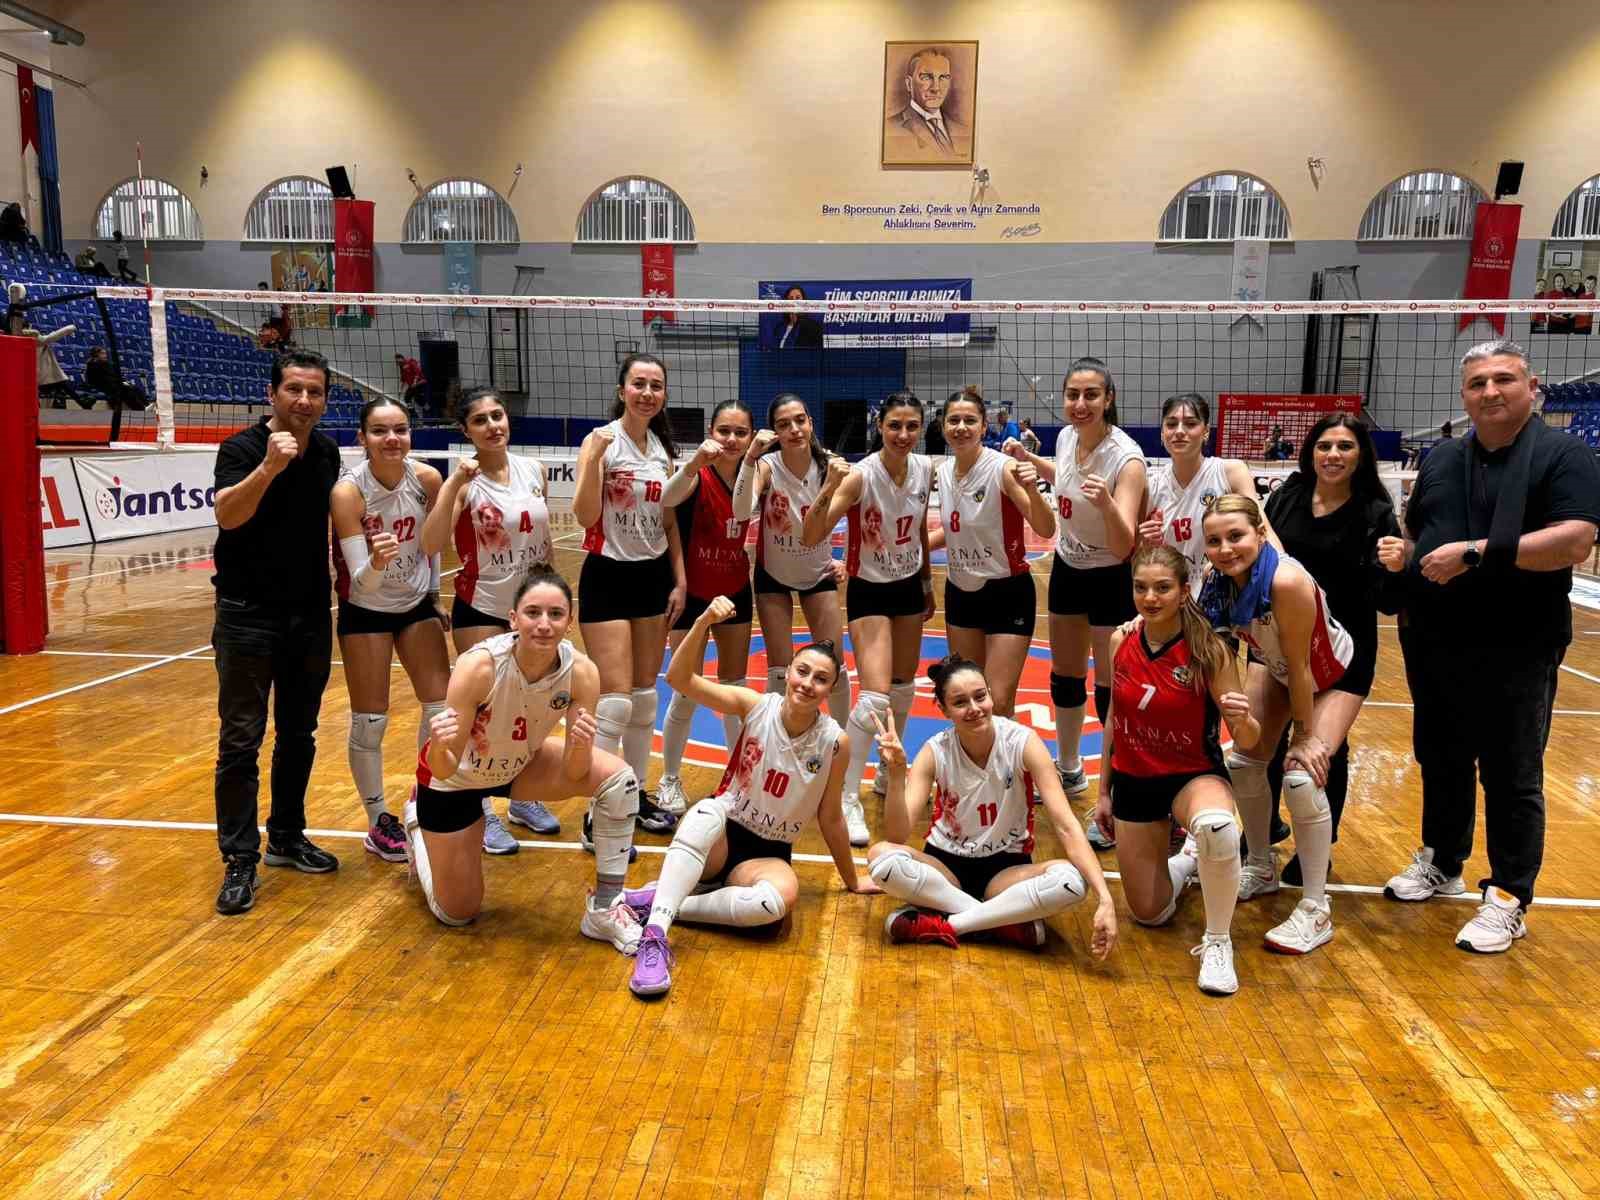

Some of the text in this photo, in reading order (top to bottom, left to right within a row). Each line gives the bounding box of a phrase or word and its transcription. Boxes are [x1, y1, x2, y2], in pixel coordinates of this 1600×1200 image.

[822, 204, 840, 214] Ben
[844, 204, 896, 217] Sporcunun
[899, 204, 922, 216] Zeki,
[926, 203, 952, 216] Çevik
[970, 204, 993, 217] Aynı
[995, 204, 1041, 214] Zamanda
[934, 218, 977, 229] Severim.
[644, 480, 662, 503] 16
[615, 511, 661, 528] MIRN
[1058, 496, 1073, 519] 18
[392, 515, 416, 543] 22
[519, 511, 534, 533] 4
[726, 517, 742, 539] 15
[895, 515, 914, 545] 17
[1172, 518, 1193, 543] 13
[1137, 683, 1157, 711] 7
[512, 716, 528, 741] 3
[763, 768, 790, 799] 10
[977, 802, 998, 827] 11
